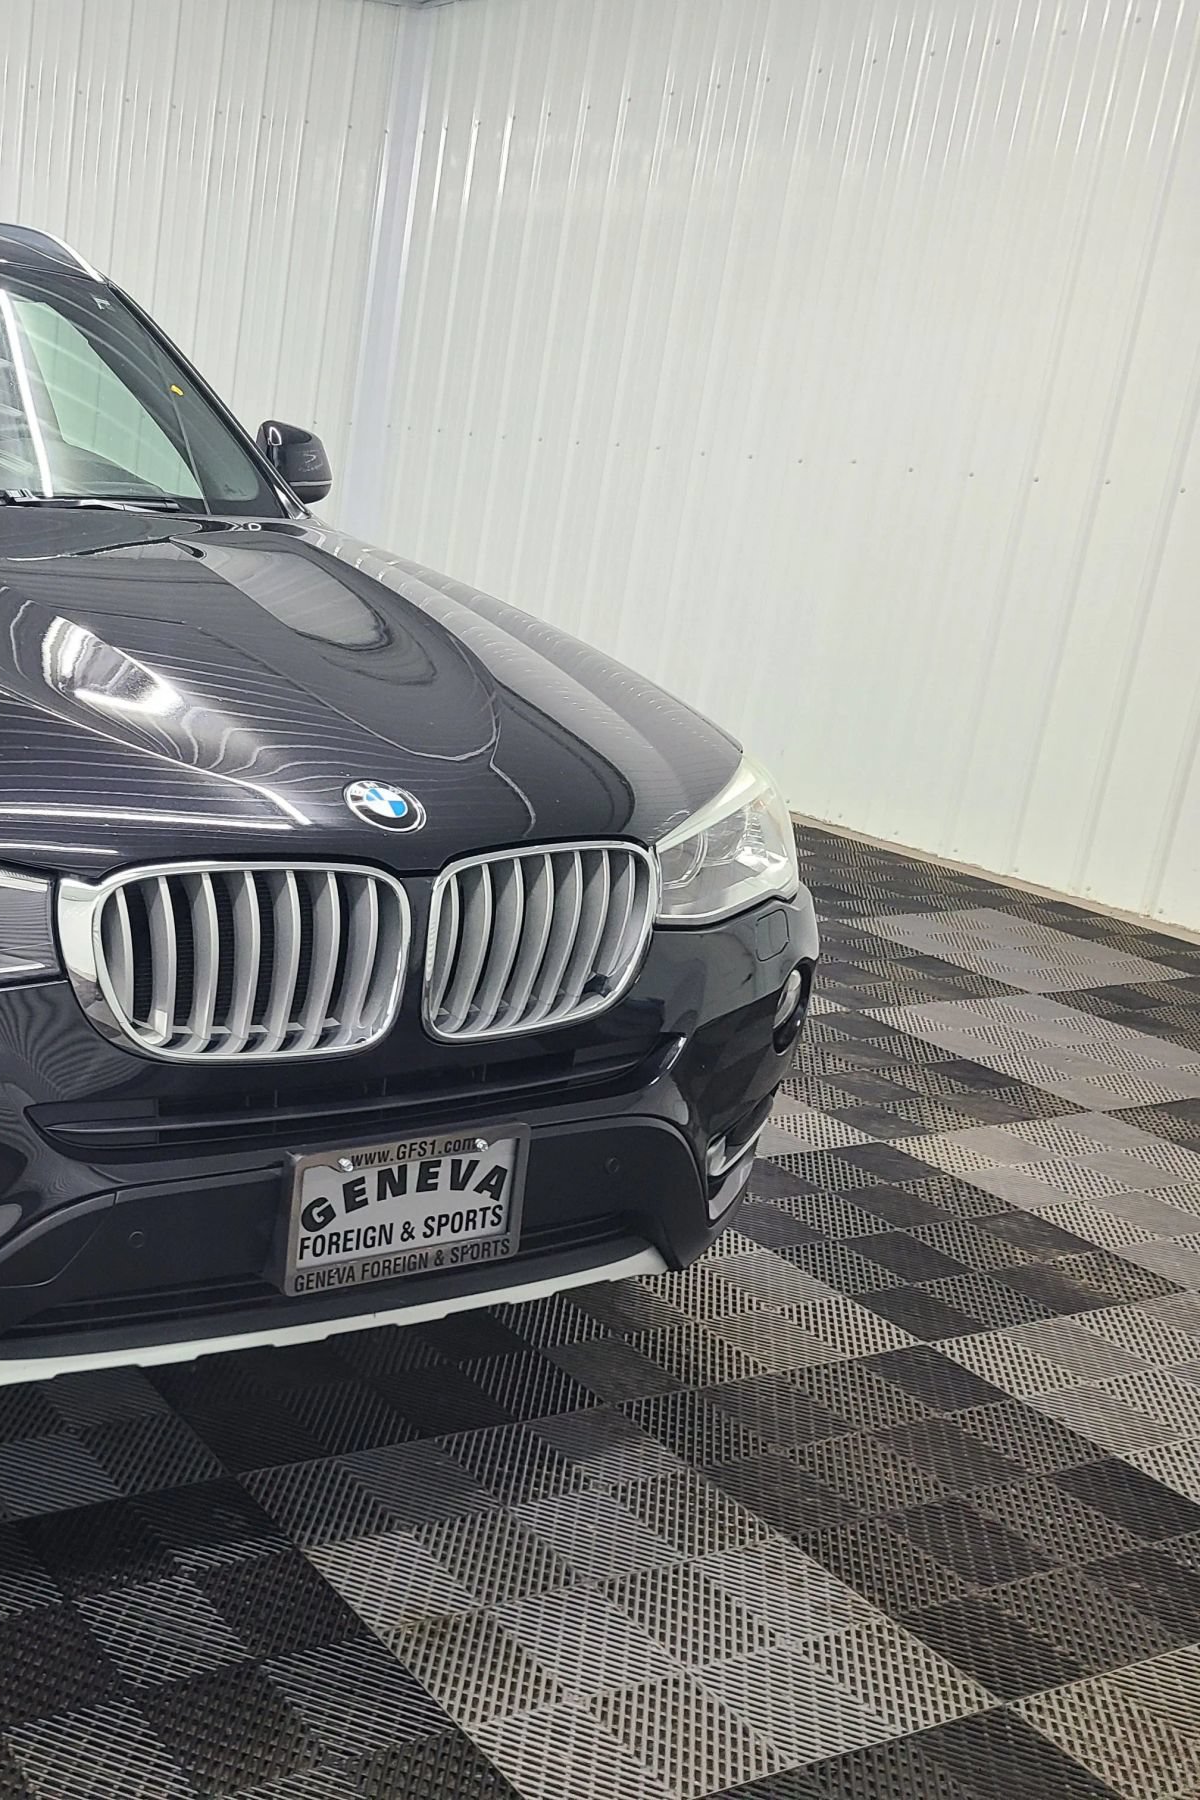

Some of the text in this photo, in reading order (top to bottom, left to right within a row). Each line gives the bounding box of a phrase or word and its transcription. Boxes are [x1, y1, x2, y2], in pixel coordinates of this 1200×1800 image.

[351, 1138, 477, 1167] www.GFS1.com
[301, 1158, 508, 1232] GENEVA
[299, 1204, 504, 1260] FOREIGN & SPORTS
[294, 1238, 511, 1293] GENEVA FOREIGN & SPORTS
